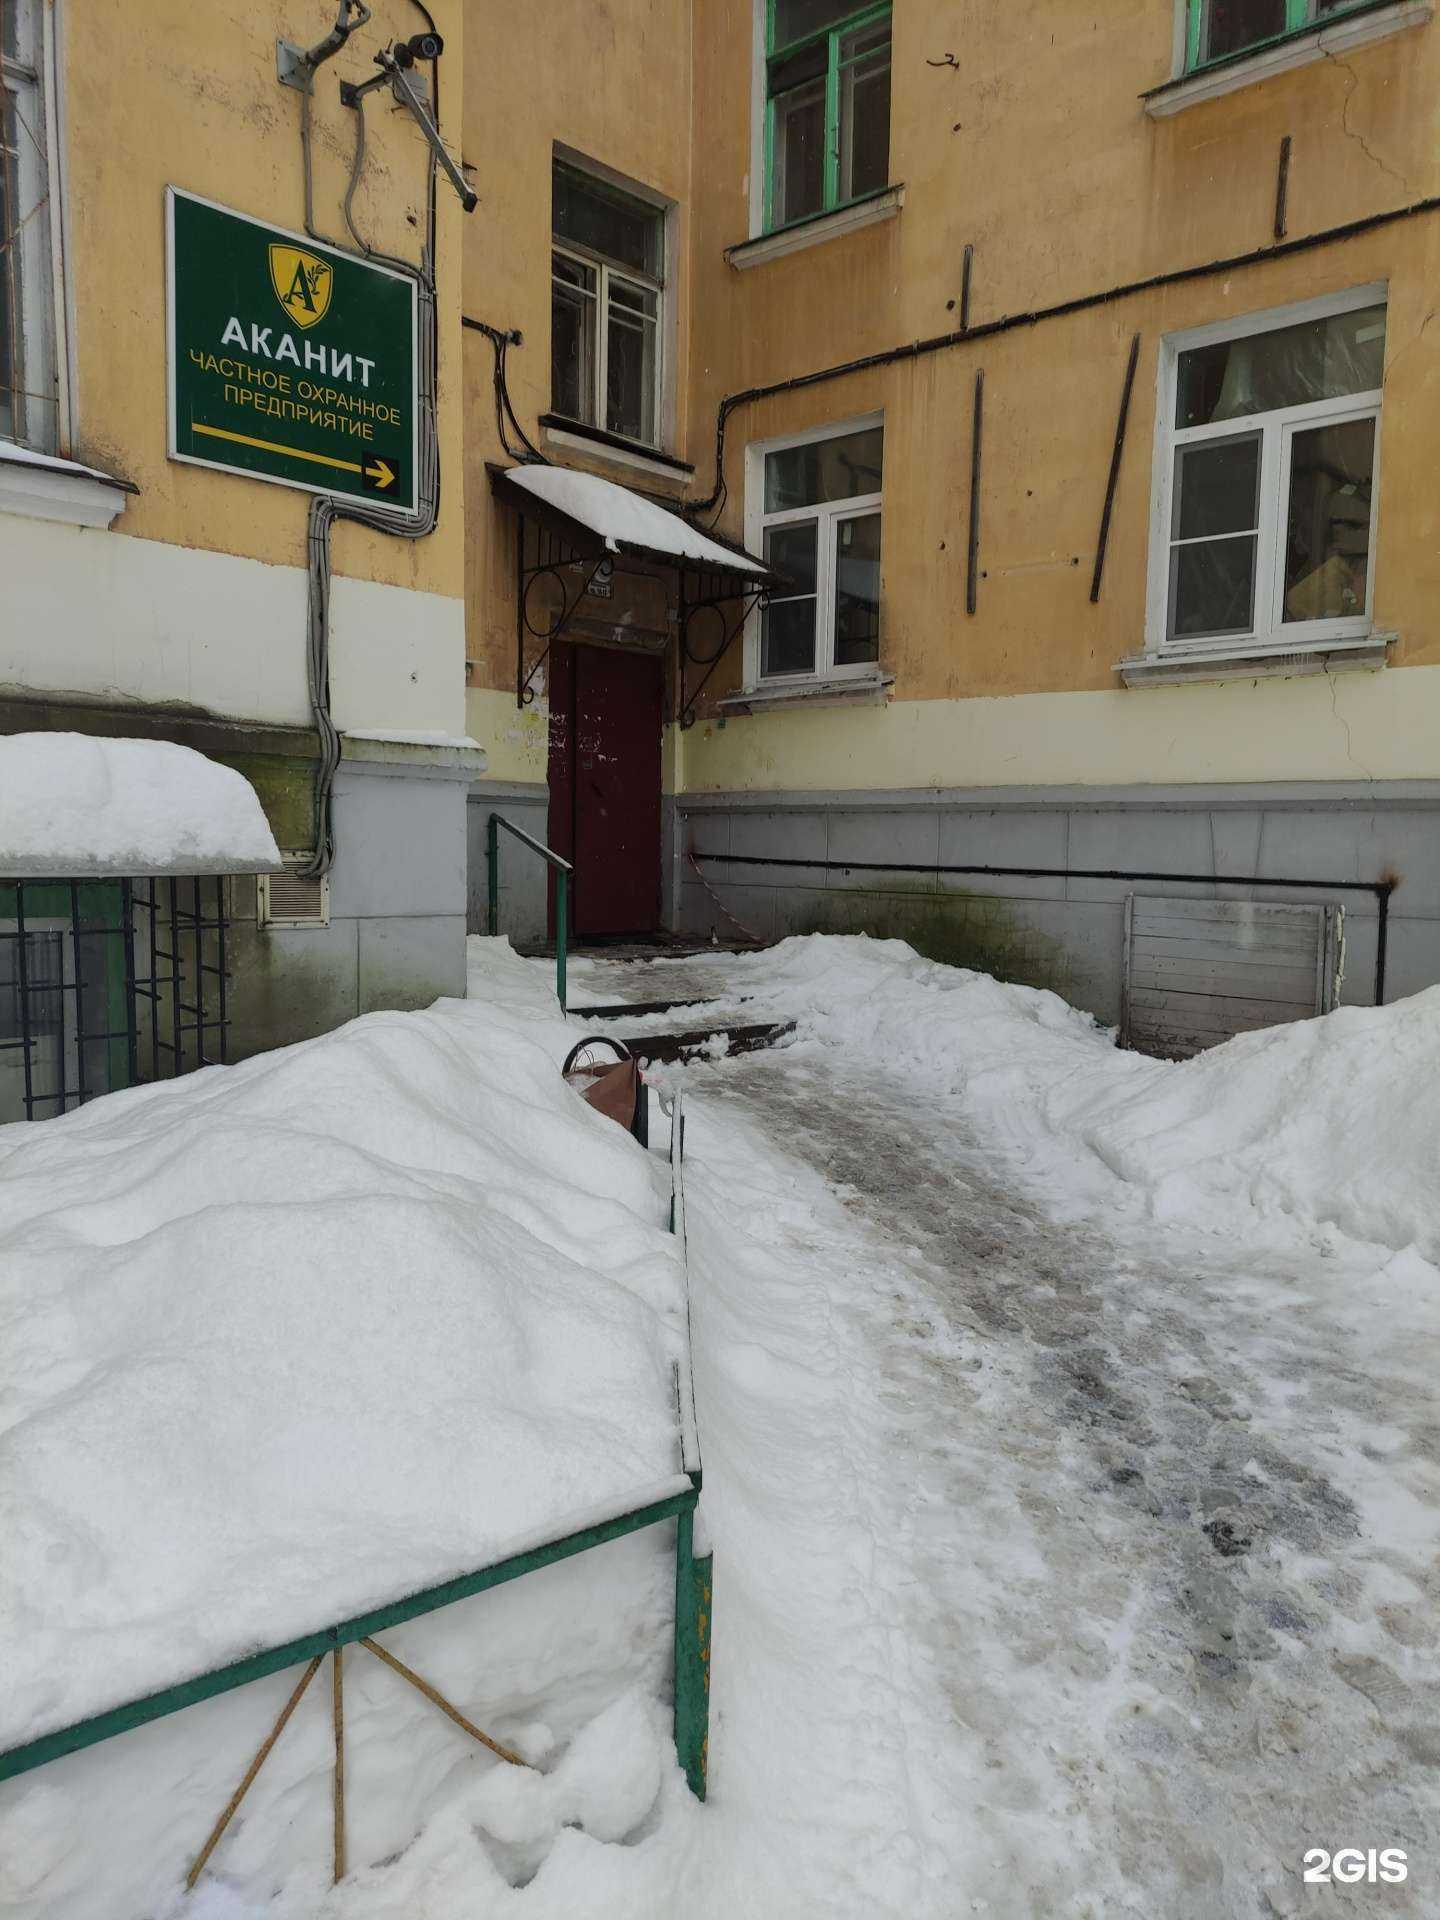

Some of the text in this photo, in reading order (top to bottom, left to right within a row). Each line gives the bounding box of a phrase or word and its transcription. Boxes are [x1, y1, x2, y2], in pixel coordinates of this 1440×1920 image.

[189, 349, 401, 426] ЧАСТНОЕ ОХРАННОЕ
[220, 317, 376, 388] АКАНИТ
[224, 384, 375, 441] ПРЕДПРИЯТИЕ
